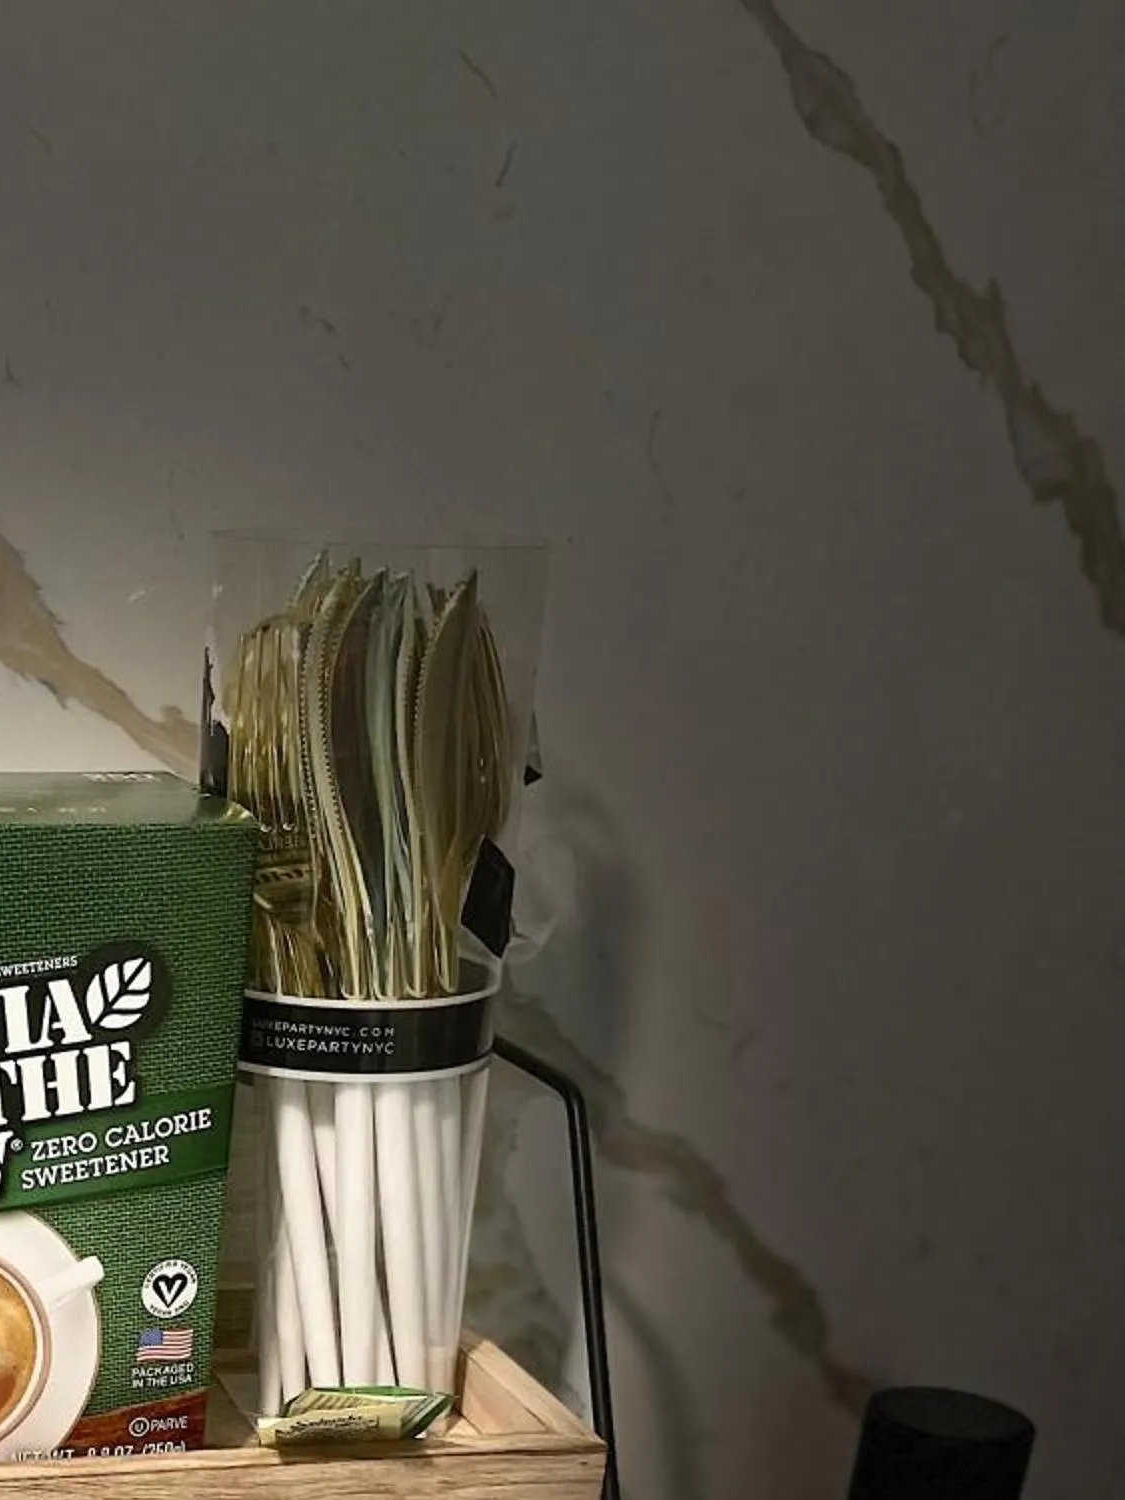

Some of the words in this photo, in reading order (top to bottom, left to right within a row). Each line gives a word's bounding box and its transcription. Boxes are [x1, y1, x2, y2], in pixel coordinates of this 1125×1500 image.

[30, 1132, 98, 1162] ZERO
[105, 1107, 213, 1149] CALORIE
[20, 1144, 171, 1190] SWEETENER
[132, 1362, 194, 1379] PACKAGED
[132, 1378, 144, 1389] IN
[146, 1376, 168, 1388] THE
[170, 1373, 193, 1386] USA
[149, 1414, 189, 1433] PARVE
